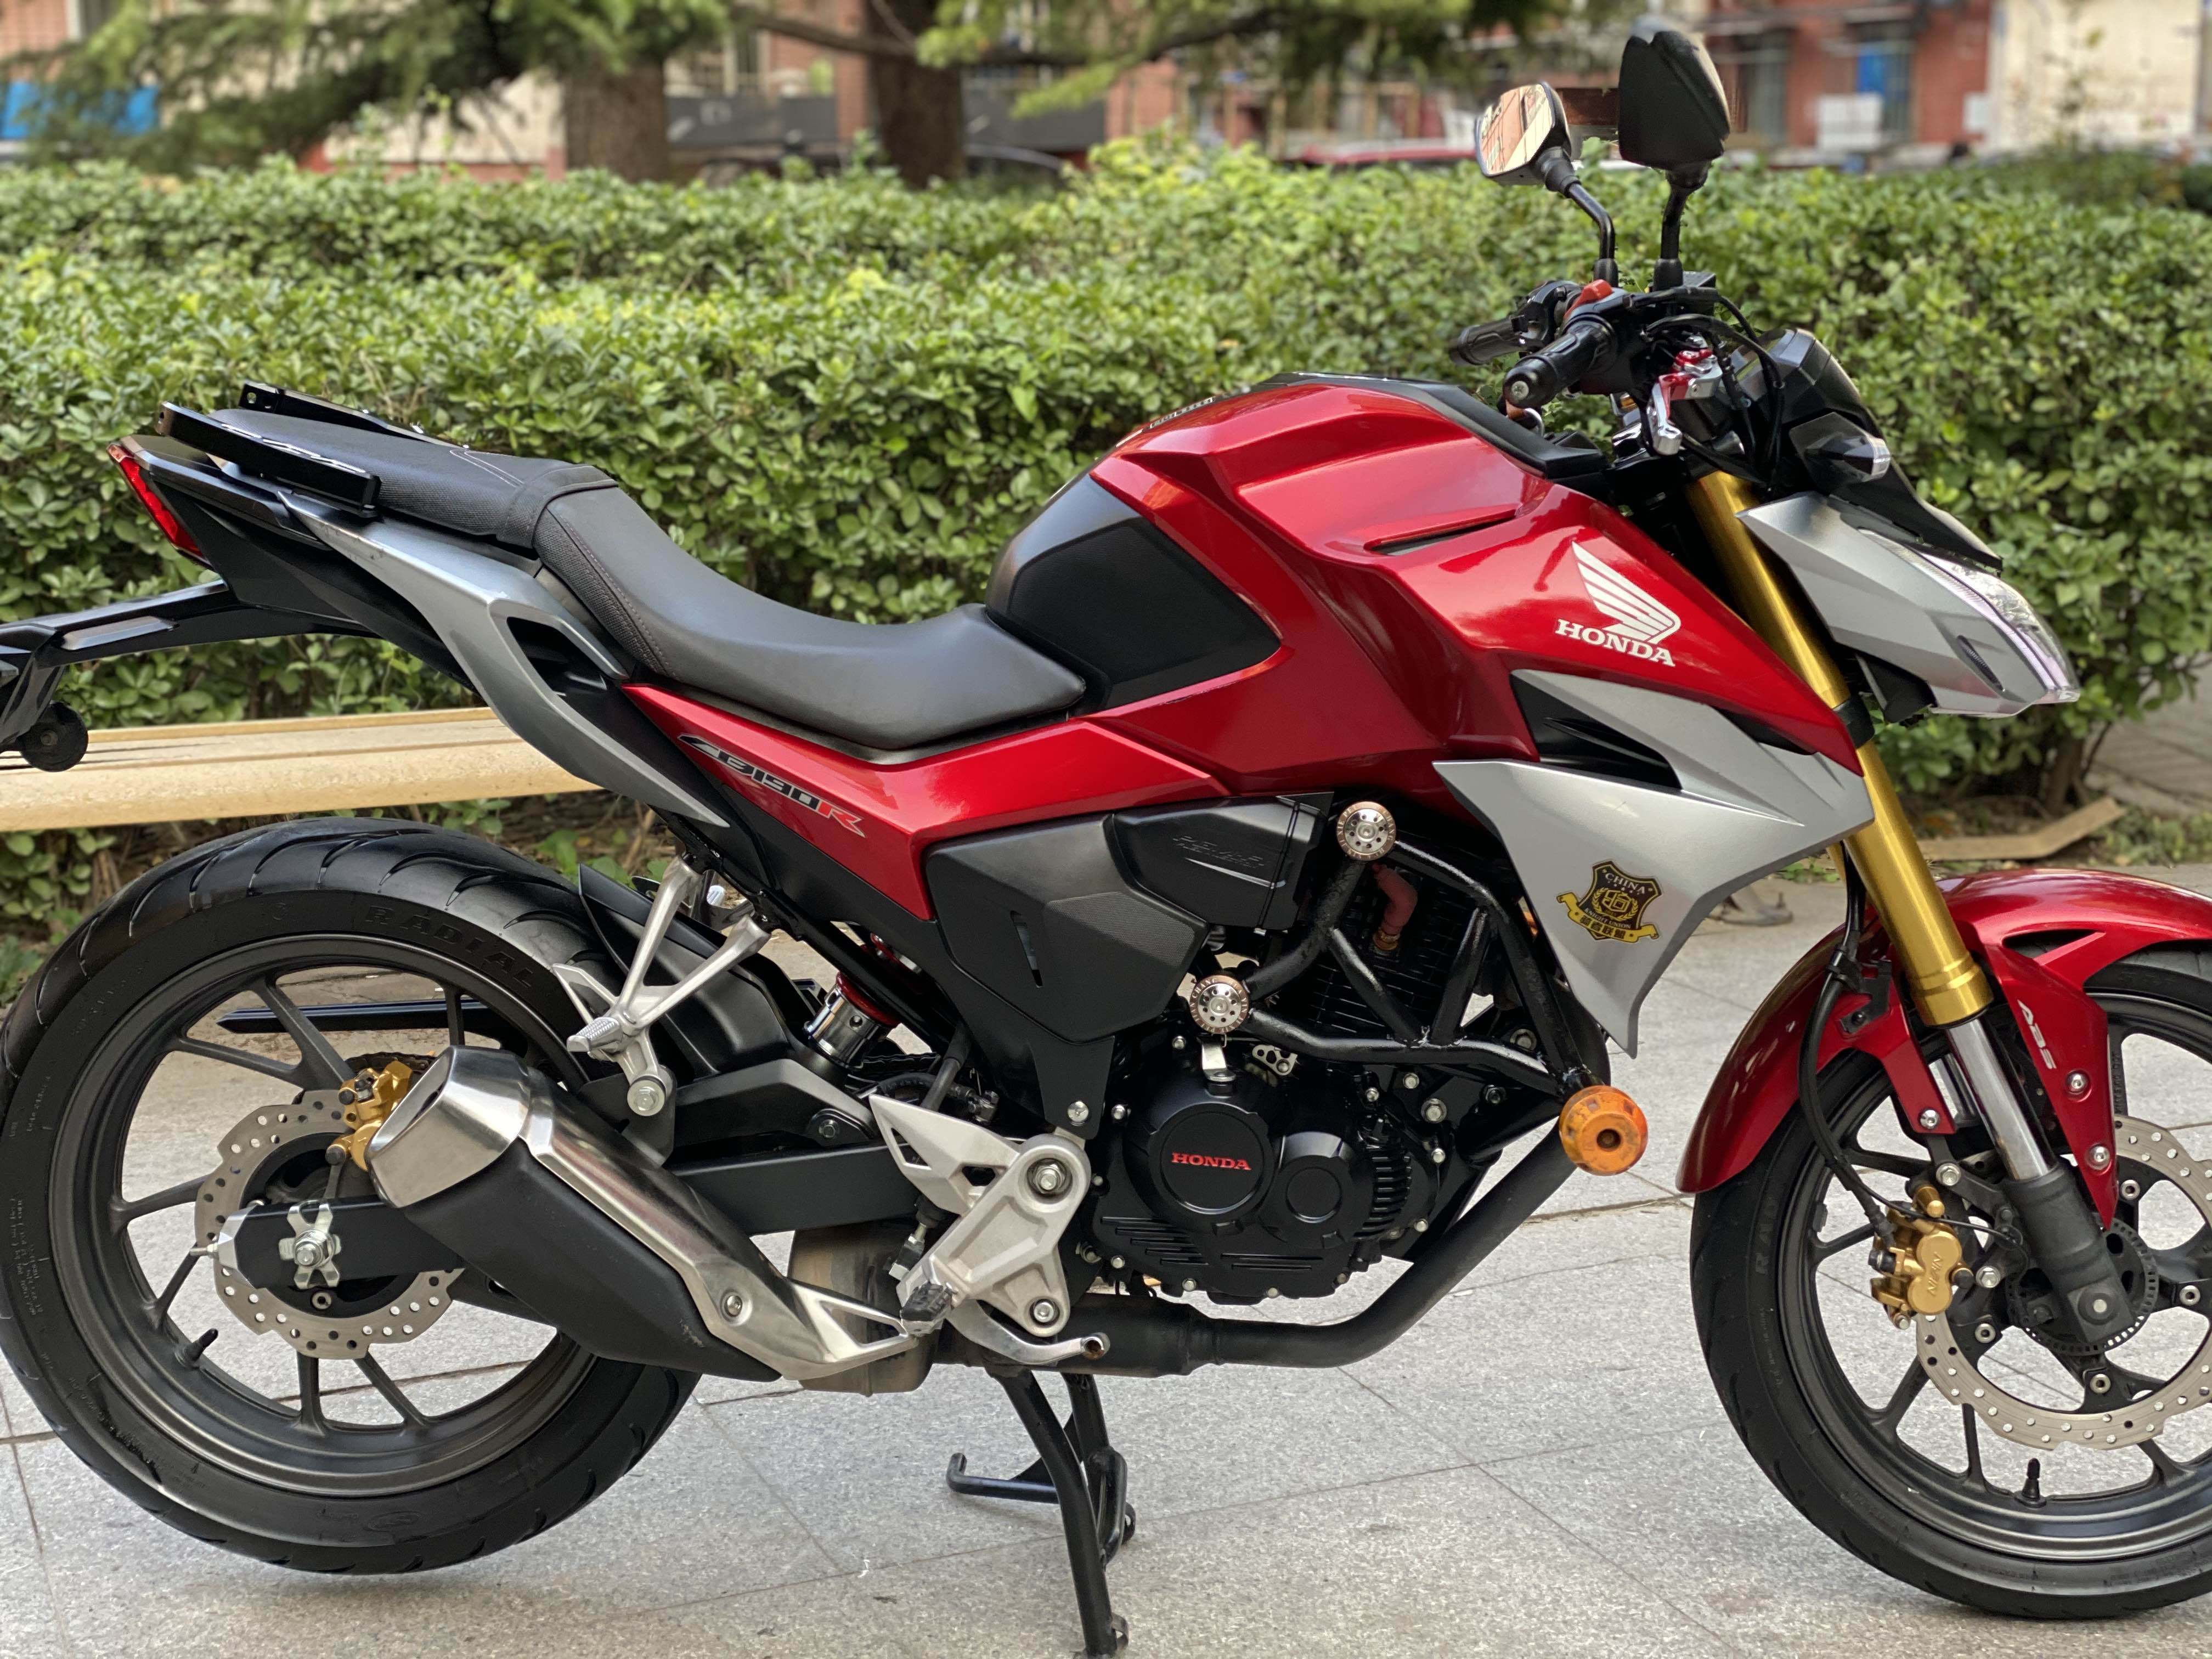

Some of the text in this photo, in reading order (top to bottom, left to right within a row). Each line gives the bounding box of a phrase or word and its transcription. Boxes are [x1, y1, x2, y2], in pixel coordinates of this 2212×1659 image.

[1555, 618, 1675, 667] HONDA
[677, 734, 866, 838] CB190R
[1605, 873, 1646, 894] CHINA
[1584, 908, 1609, 923] KNIGHT
[1609, 917, 1632, 929] UNION
[2017, 999, 2057, 1069] ABS
[1171, 1152, 1251, 1170] HONDA
